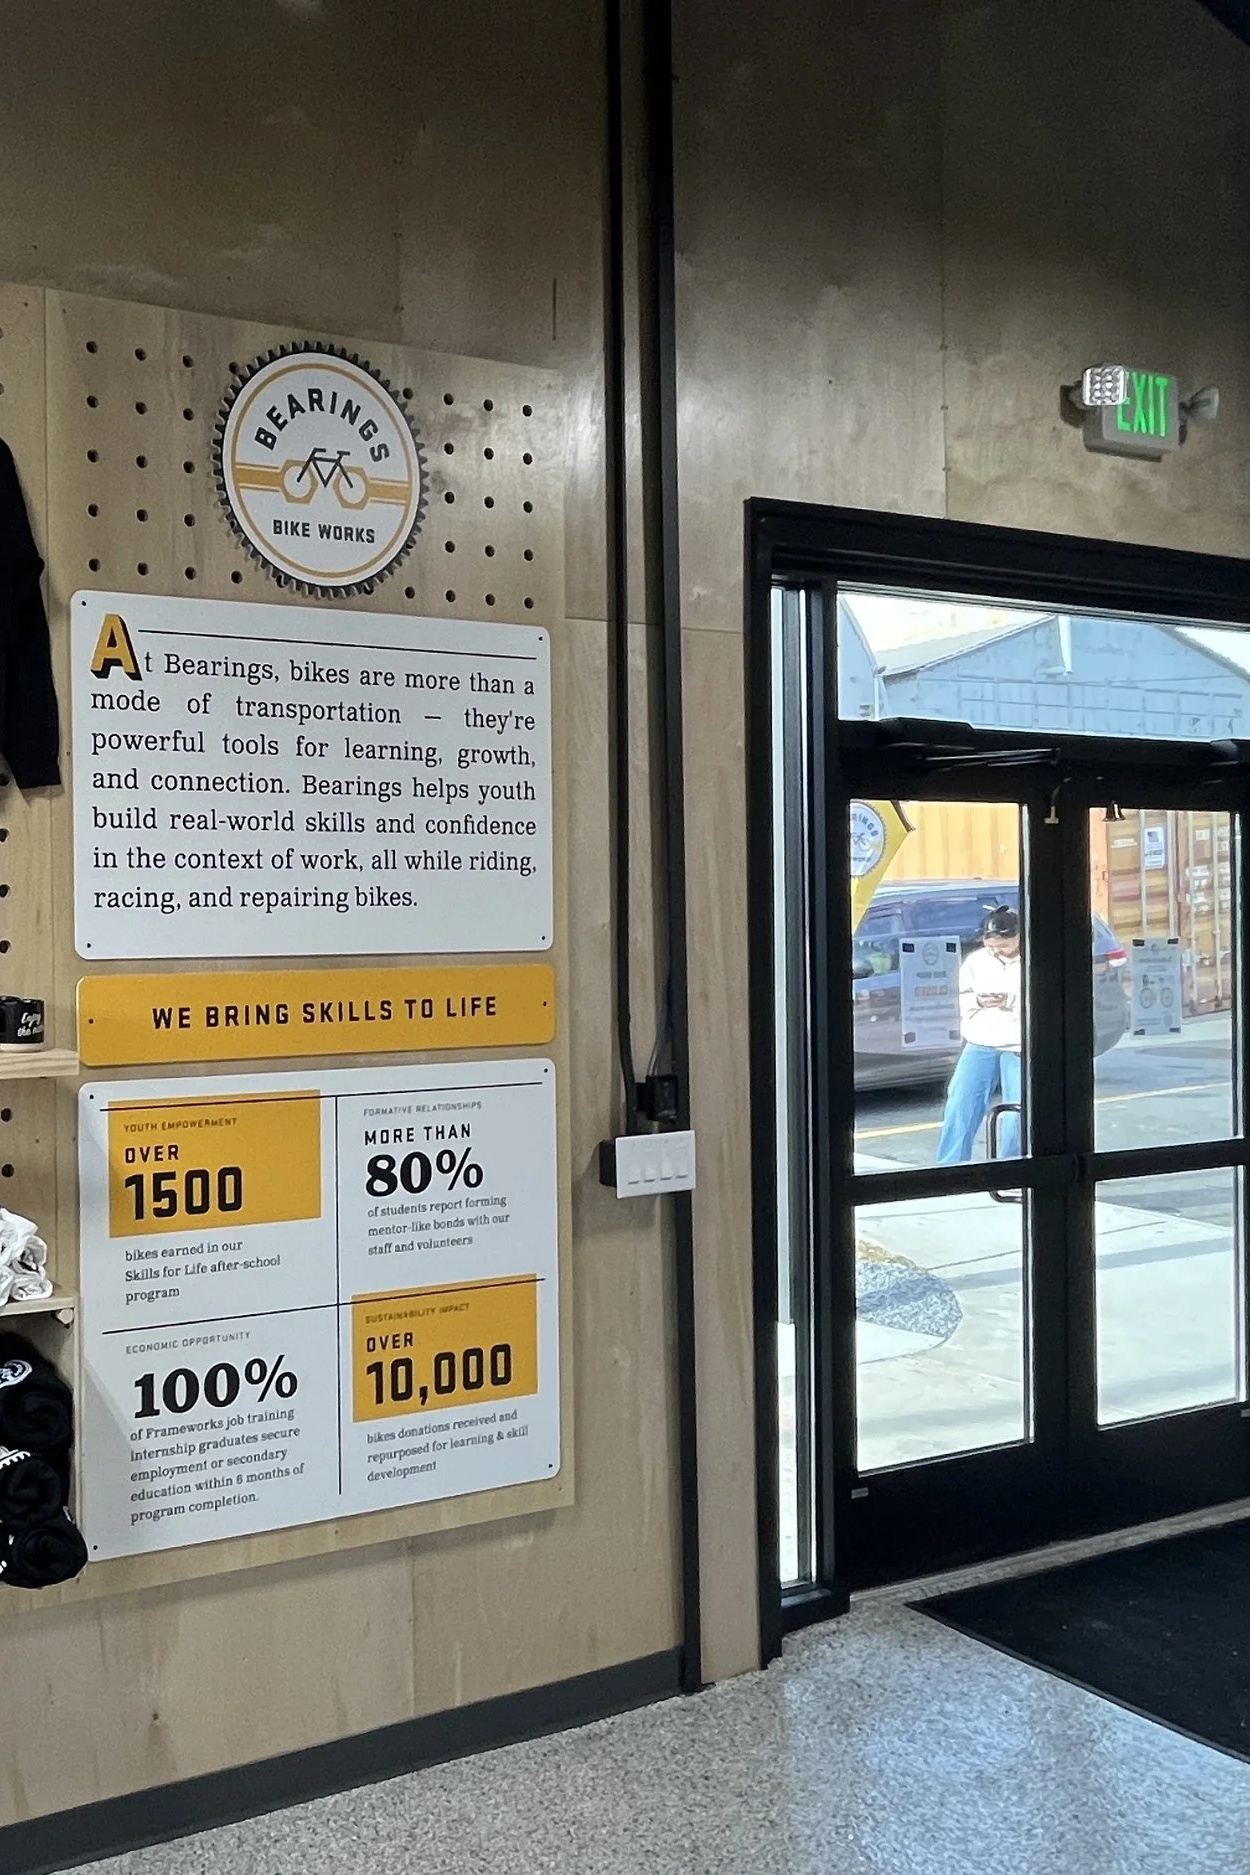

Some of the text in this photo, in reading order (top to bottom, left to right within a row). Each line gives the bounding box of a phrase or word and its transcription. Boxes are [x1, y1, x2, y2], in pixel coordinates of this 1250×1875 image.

[254, 388, 390, 462] BEARINGS
[273, 519, 375, 543] BIKE WORKS
[164, 653, 279, 685] Bearings,
[289, 660, 350, 684] bikes
[360, 669, 395, 686] are
[405, 673, 460, 691] more
[470, 672, 515, 694] than
[524, 680, 534, 695] a
[91, 690, 535, 735] mode of transportation they're
[91, 730, 535, 769] powerful tools for learning, growth,
[93, 768, 536, 805] and connection. Bearings helps youth
[92, 806, 536, 835] build real-world skills and confidence
[93, 847, 536, 876] in the context of work, all while riding,
[94, 886, 417, 914] racing, and repairing bikes.
[152, 996, 497, 1029] WE BRING SKILLS TO LIFE
[364, 1101, 482, 1116] FORMATIVE RELATIONSHIPS
[124, 1118, 237, 1133] YOUTH EMPOWERMENT
[365, 1123, 471, 1145] MORE THAN
[125, 1145, 179, 1163] OVER
[365, 1147, 484, 1197] 80%
[125, 1166, 242, 1220] 1500
[368, 1196, 507, 1217] of students report forming
[368, 1214, 510, 1236] mentor-like bonds with our
[126, 1241, 243, 1261] bikes earned in our
[368, 1236, 473, 1255] staff and volunteers
[125, 1255, 281, 1282] Skills for Life after-school
[126, 1286, 180, 1305] program
[366, 1303, 470, 1324] SUSTAINABILITY IMPACT
[126, 1331, 251, 1354] ECONOMIC OPPORTUNITY
[367, 1332, 413, 1352] OVER
[134, 1354, 298, 1419] 100%
[366, 1344, 512, 1406] 10,000
[130, 1409, 295, 1441] of Frameworks job training
[367, 1410, 518, 1444] bikes donations received and
[131, 1427, 300, 1461] internship graduates secure
[367, 1426, 528, 1463] repurposed for learning & skill
[131, 1449, 288, 1481] employment or secondary
[367, 1461, 436, 1481] development
[131, 1463, 305, 1501] education within 6 months of
[131, 1492, 258, 1525] program completion.
